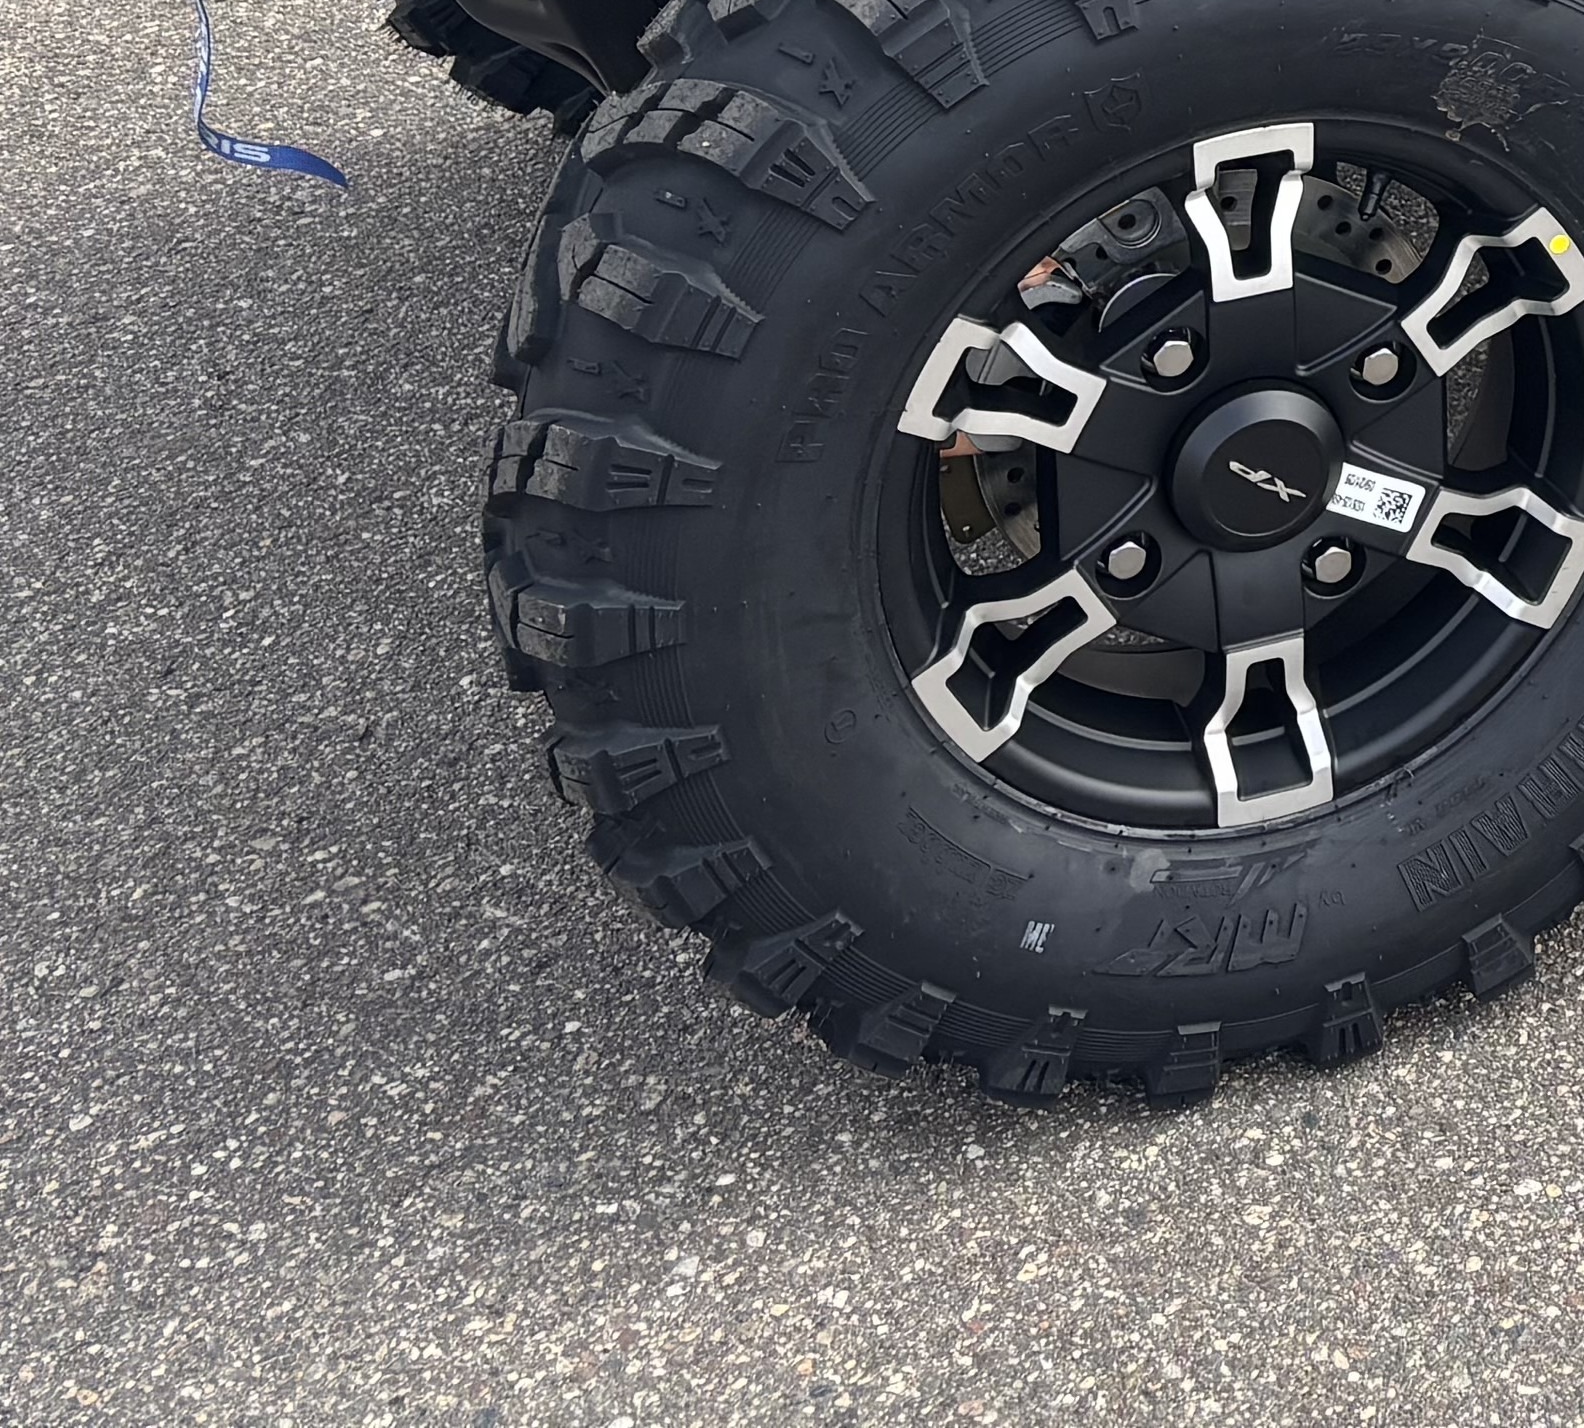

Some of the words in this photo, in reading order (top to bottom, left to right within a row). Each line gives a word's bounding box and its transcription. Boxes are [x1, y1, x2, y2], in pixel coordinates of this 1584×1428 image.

[776, 326, 872, 463] PRO
[860, 115, 1079, 316] ARMOR
[1229, 458, 1308, 505] XP
